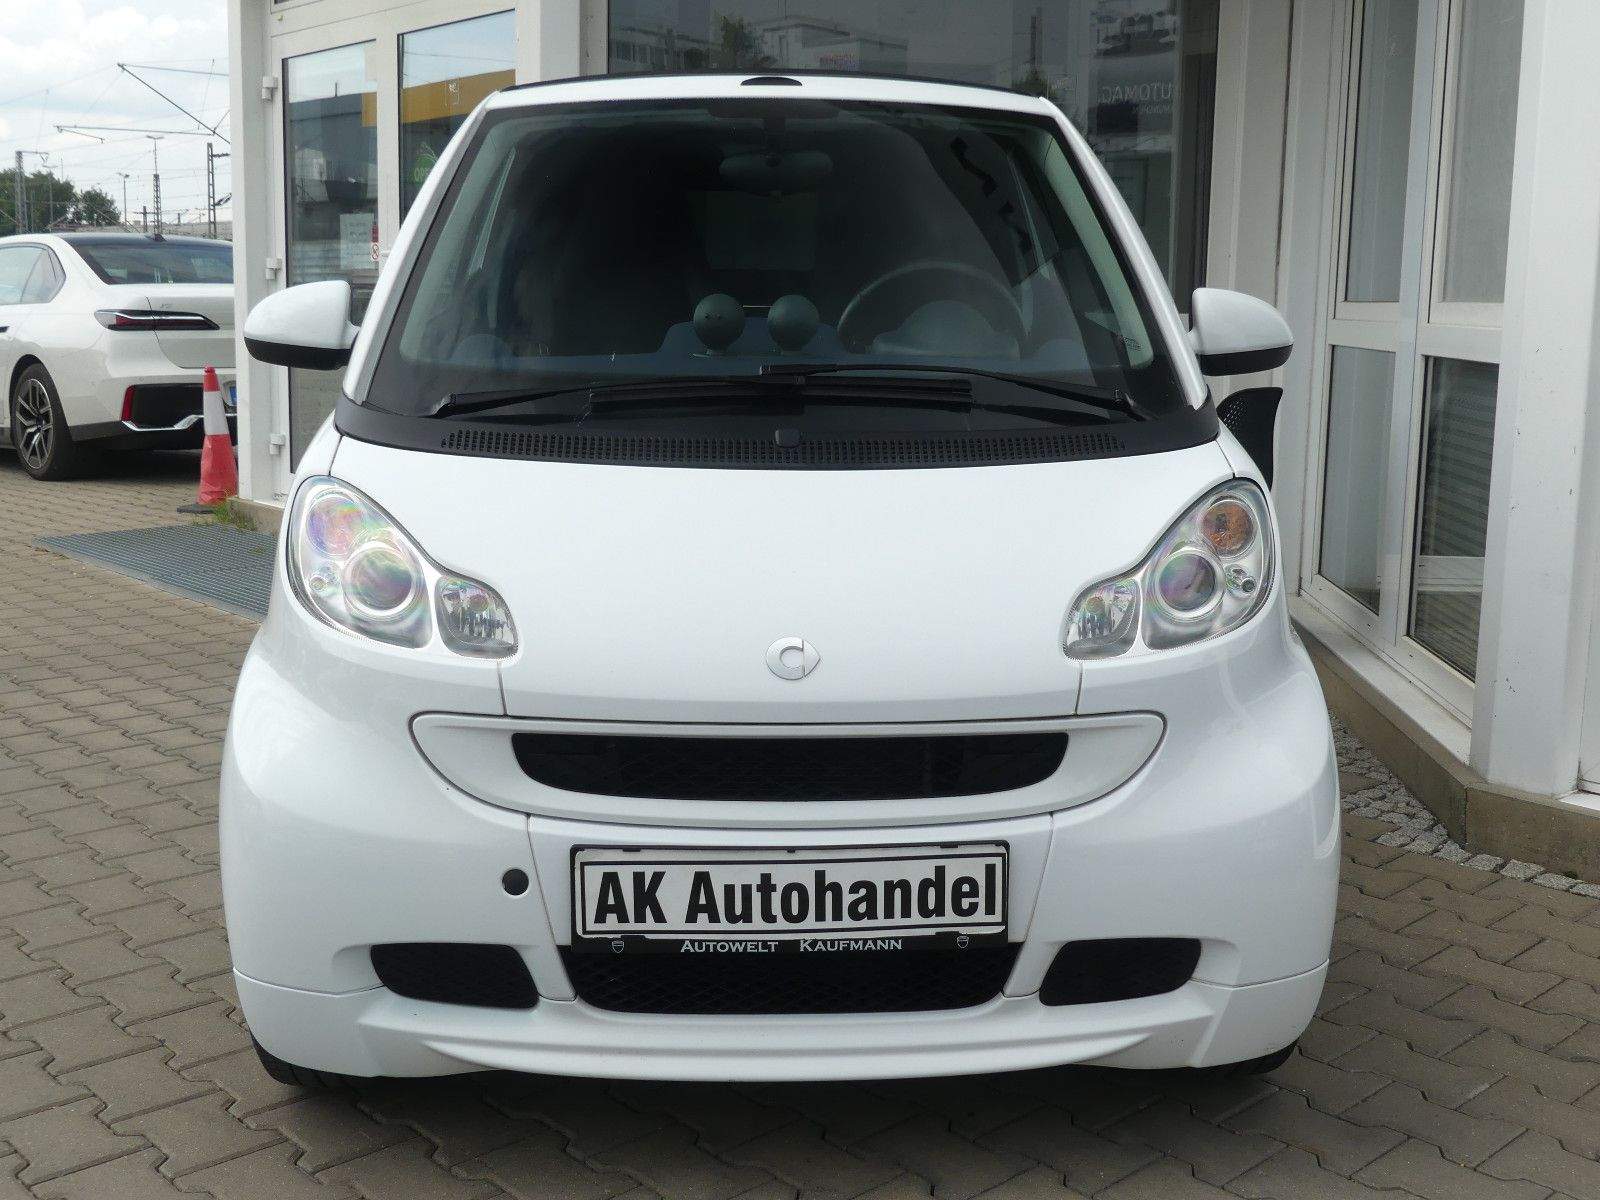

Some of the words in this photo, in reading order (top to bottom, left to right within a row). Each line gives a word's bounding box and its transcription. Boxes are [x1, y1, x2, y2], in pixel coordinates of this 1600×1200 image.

[593, 870, 668, 924] AK
[684, 863, 997, 925] Autohandel
[680, 939, 779, 953] AUTOWELT
[799, 938, 903, 952] KAUFMANN
